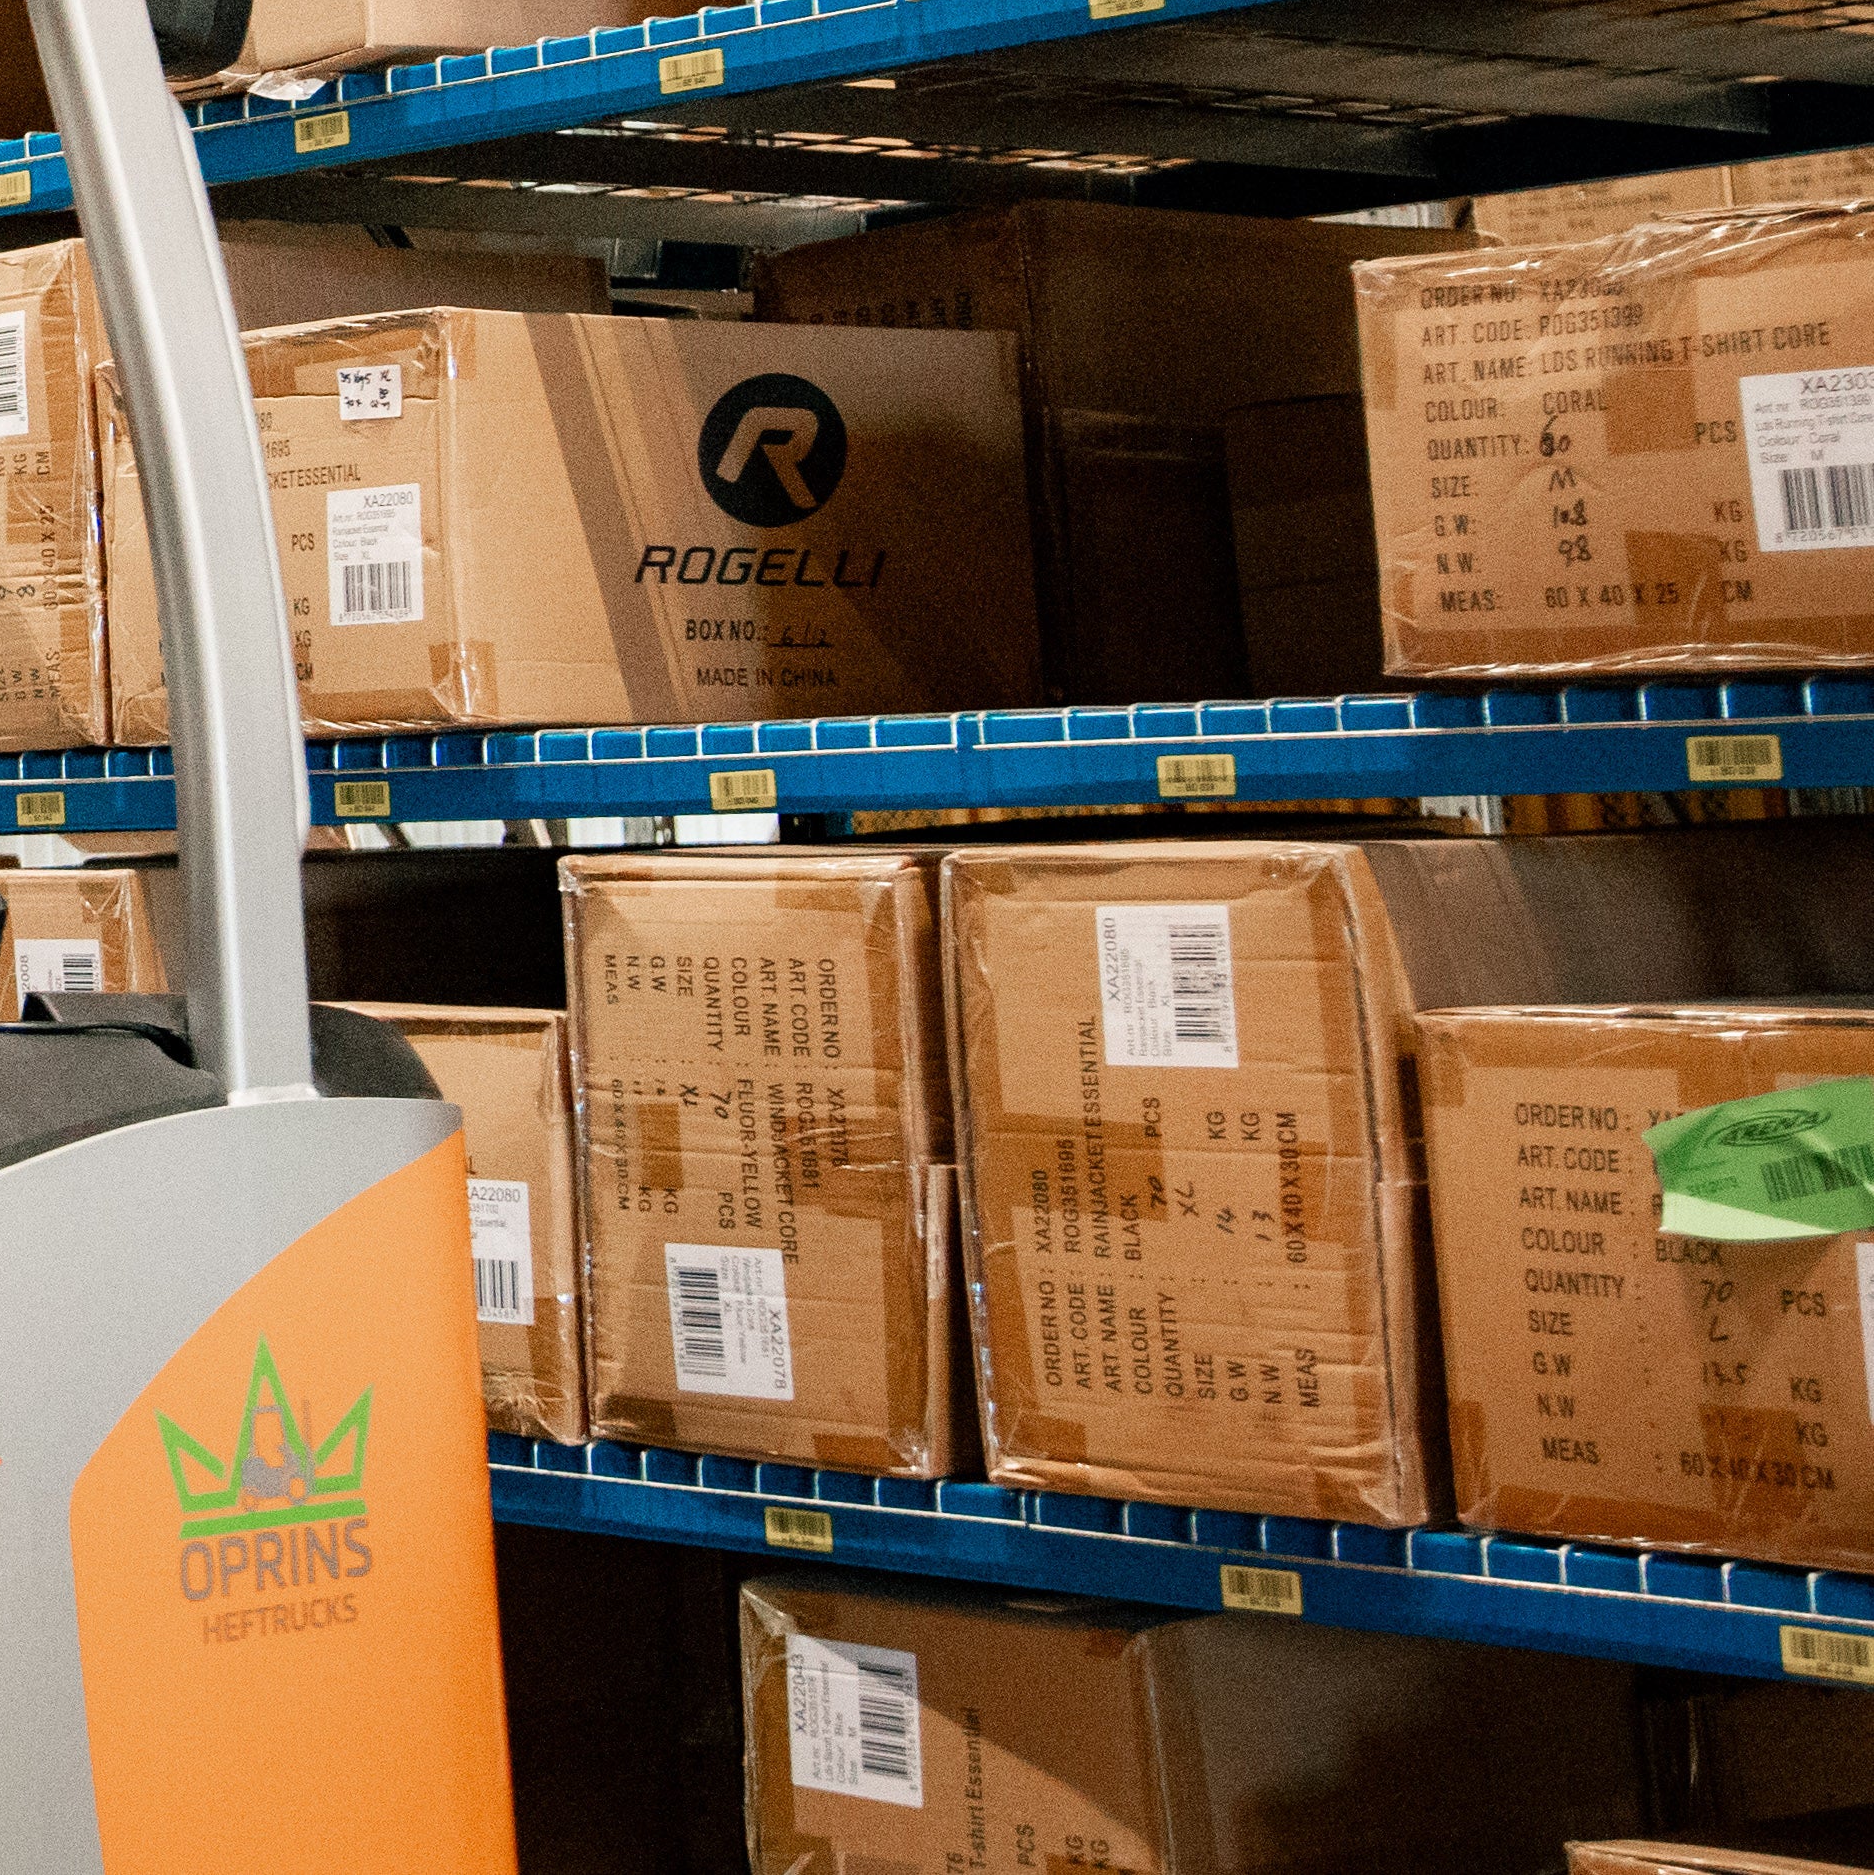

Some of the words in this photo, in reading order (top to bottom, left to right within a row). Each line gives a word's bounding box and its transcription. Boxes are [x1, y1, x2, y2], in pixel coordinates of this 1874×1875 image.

[1584, 339, 1674, 369] RUNNING
[1772, 322, 1831, 352] CORE
[1541, 388, 1611, 416] CORAL
[1693, 420, 1738, 445] PCS
[13, 452, 28, 475] KG
[35, 450, 51, 475] CM
[363, 490, 414, 508] XA22080
[1713, 499, 1745, 523] KG
[291, 533, 315, 553] PCS
[1719, 539, 1749, 563] KG
[634, 544, 887, 588] ROGELLI
[293, 597, 311, 617] KG
[1544, 585, 1569, 609] 60
[1597, 583, 1625, 606] 40
[1652, 581, 1680, 605] 25
[1721, 578, 1754, 604] CM
[685, 618, 725, 642] BOX
[697, 667, 749, 687] MADE
[755, 668, 774, 687] IN
[780, 668, 839, 688] CHINA
[676, 955, 693, 997] SIZE
[759, 957, 776, 999] ART.
[789, 957, 807, 999] ART.
[1102, 916, 1121, 1002] XA22080
[703, 955, 724, 1052] QUANTITY
[731, 956, 751, 1037] COLOUR
[817, 958, 839, 1026] ORDER
[762, 1002, 781, 1057] NAME
[791, 1003, 810, 1057] CODE
[823, 1030, 841, 1059] NO
[604, 954, 618, 1006] MEAS
[617, 1182, 630, 1211] CM
[1077, 1015, 1101, 1126] ESSENTIAL
[1142, 1097, 1162, 1139] PCS
[1206, 1111, 1227, 1141] KG
[1241, 1111, 1261, 1142] KG
[1276, 1112, 1297, 1145] CM
[1515, 1102, 1585, 1130] ORDER
[1588, 1107, 1620, 1132] NO
[737, 1078, 762, 1230] FLUOR-YELLOW
[1279, 1148, 1298, 1172] 30
[1563, 1146, 1620, 1174] CODE
[470, 1186, 521, 1204] A22080
[638, 1185, 652, 1213] KG
[663, 1186, 678, 1215] KG
[718, 1191, 735, 1231] PCS
[1031, 1169, 1052, 1253] XA22080
[1084, 1131, 1112, 1260] RAINJACKET
[1174, 1180, 1200, 1218] XL
[1282, 1194, 1301, 1218] 40
[1565, 1189, 1624, 1215] NAME
[778, 1211, 799, 1265] CORE
[1119, 1193, 1143, 1262] BLACK
[1521, 1226, 1606, 1256] COLOUR
[1654, 1238, 1724, 1267] BLACK
[1287, 1238, 1307, 1264] 60
[1038, 1280, 1056, 1309] NO
[1524, 1268, 1625, 1299] QUANTITY
[1781, 1288, 1828, 1317] PCS
[1067, 1282, 1089, 1341] CODE
[1097, 1284, 1117, 1343] NAME
[1527, 1309, 1574, 1337] SIZE
[768, 1309, 788, 1390] XA22078
[1041, 1312, 1063, 1387] ORDER
[1128, 1307, 1153, 1395] COLOUR
[1157, 1292, 1185, 1398] QUANTITY
[1075, 1345, 1093, 1390] ART.
[1104, 1348, 1123, 1392] ART.
[1193, 1353, 1217, 1400] SIZE
[1295, 1348, 1320, 1408] MEAS
[1789, 1377, 1822, 1405] KG
[1542, 1438, 1600, 1465] MEAS
[1796, 1420, 1829, 1448] KG
[180, 1517, 372, 1602] OPRINS
[202, 1592, 359, 1645] HEFTRUCKS
[960, 1705, 983, 1800] Essential
[965, 1805, 987, 1870] T-shirt
[1015, 1824, 1037, 1867] PCS
[1064, 1834, 1087, 1867] KG
[1089, 1839, 1110, 1871] KG
